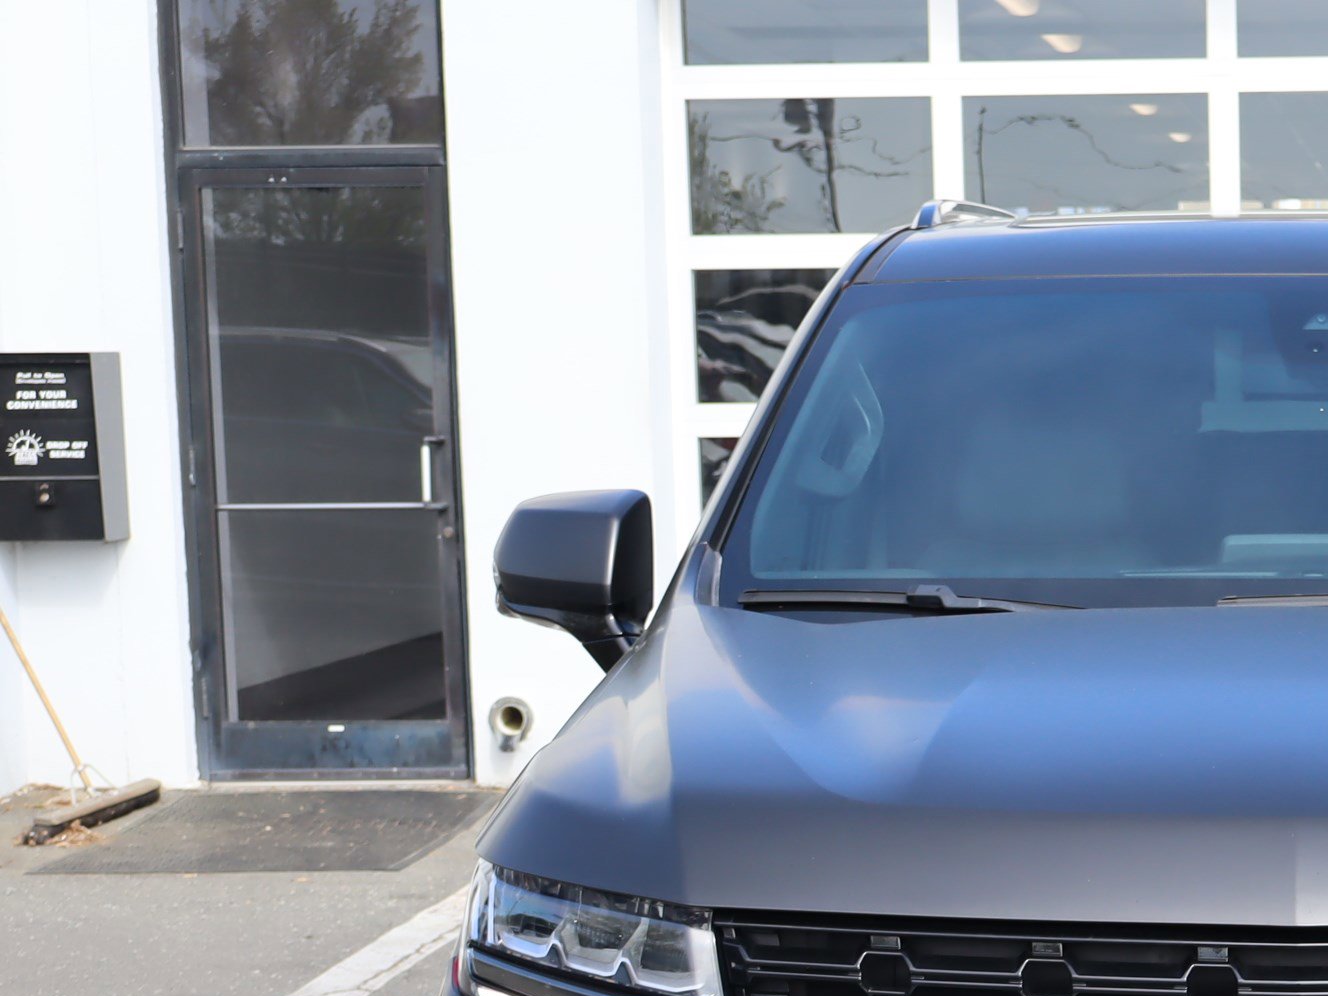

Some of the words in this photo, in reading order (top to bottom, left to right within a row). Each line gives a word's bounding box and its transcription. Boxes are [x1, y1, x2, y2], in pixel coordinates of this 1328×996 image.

[16, 391, 37, 400] FOR
[39, 390, 67, 399] YOUR
[6, 399, 78, 410] CONVENIENCE
[49, 450, 86, 459] SERVICE
